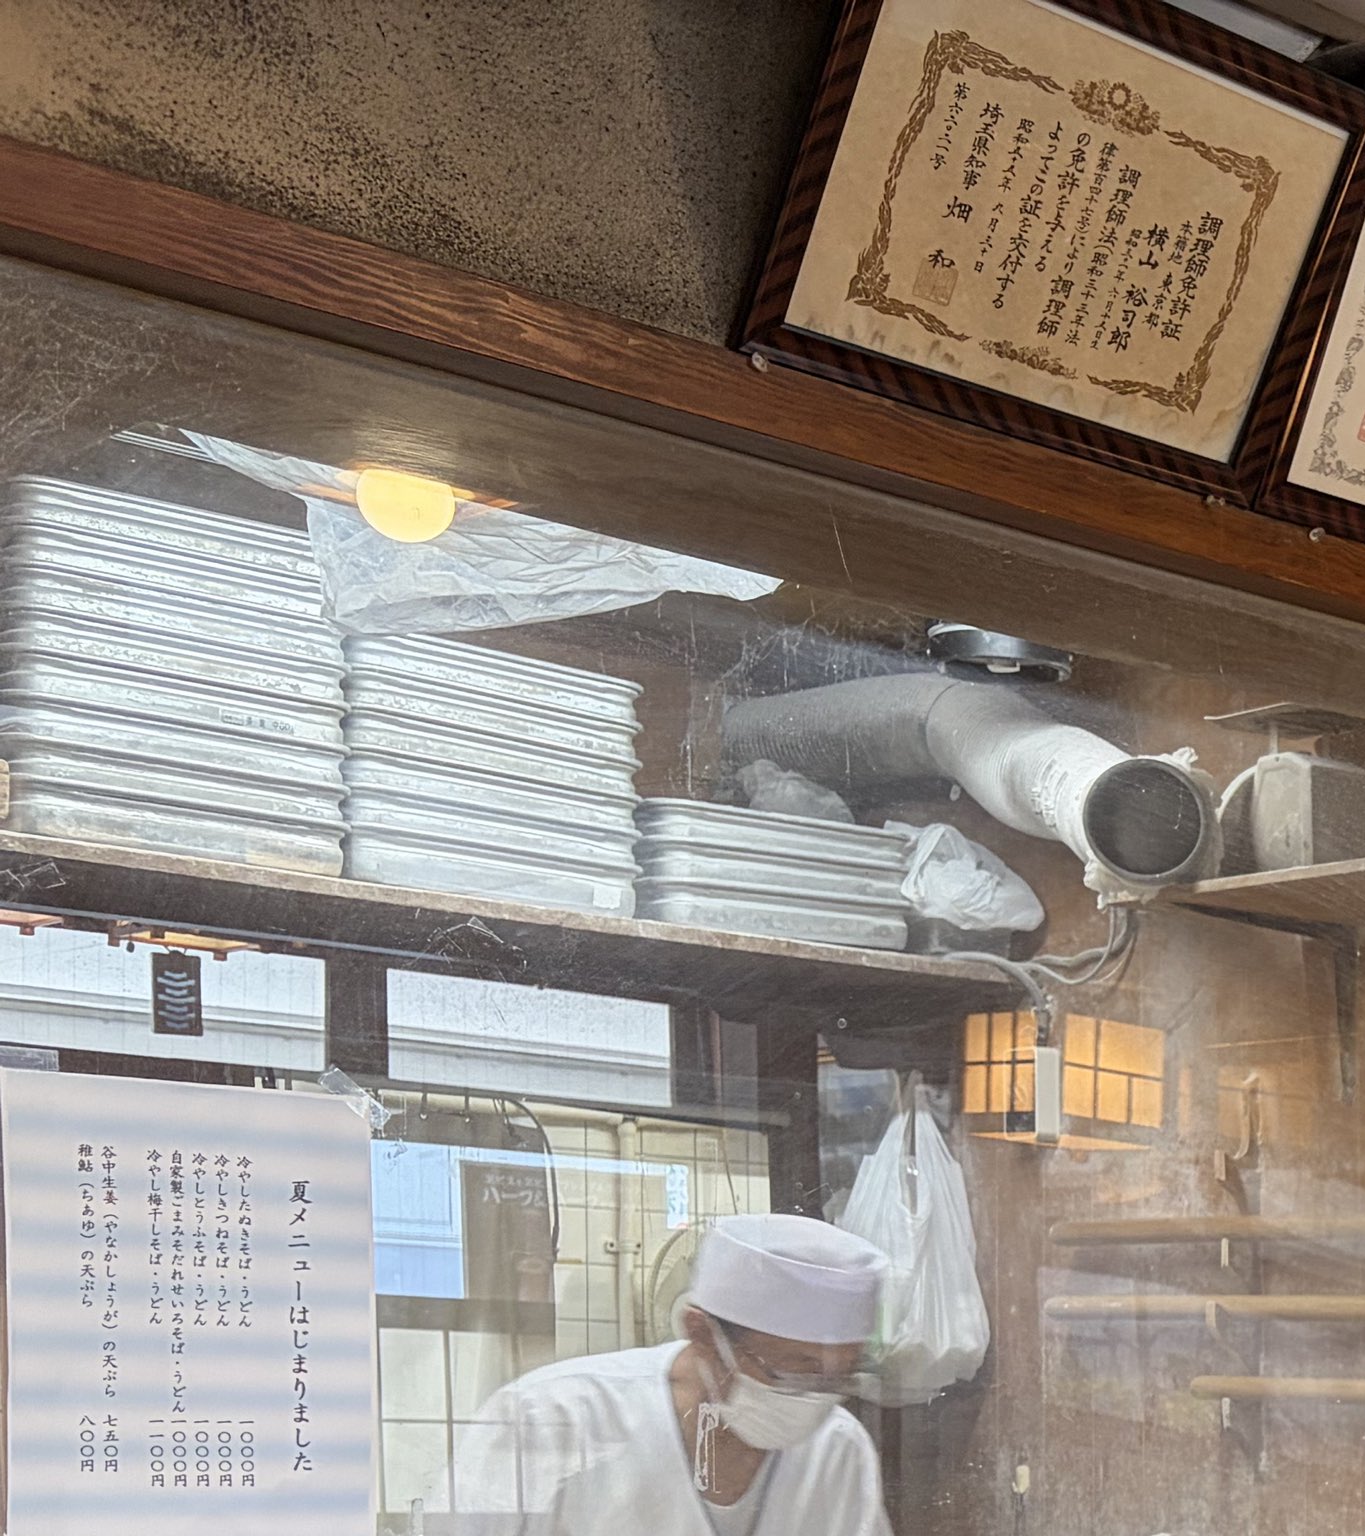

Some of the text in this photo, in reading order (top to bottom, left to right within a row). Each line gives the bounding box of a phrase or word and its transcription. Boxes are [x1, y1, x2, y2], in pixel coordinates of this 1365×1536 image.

[962, 101, 1005, 191] 埼玉県知事
[991, 120, 1064, 310] よってこの証を交付する
[1034, 132, 1092, 273] の免許を与える
[1138, 222, 1170, 271] 横山
[1141, 271, 1173, 330] 東京都
[1160, 210, 1225, 342] 調理師免許証
[147, 1149, 164, 1324] 冷やし梅干しそば・うどん
[192, 1153, 208, 1326] 冷やしとうふそば・うどん
[214, 1155, 231, 1326] 冷やしきつねそば・うどん
[237, 1156, 253, 1327] 冷やしたぬきそば・うどん
[288, 1181, 313, 1471] 夏メニューはじまりました
